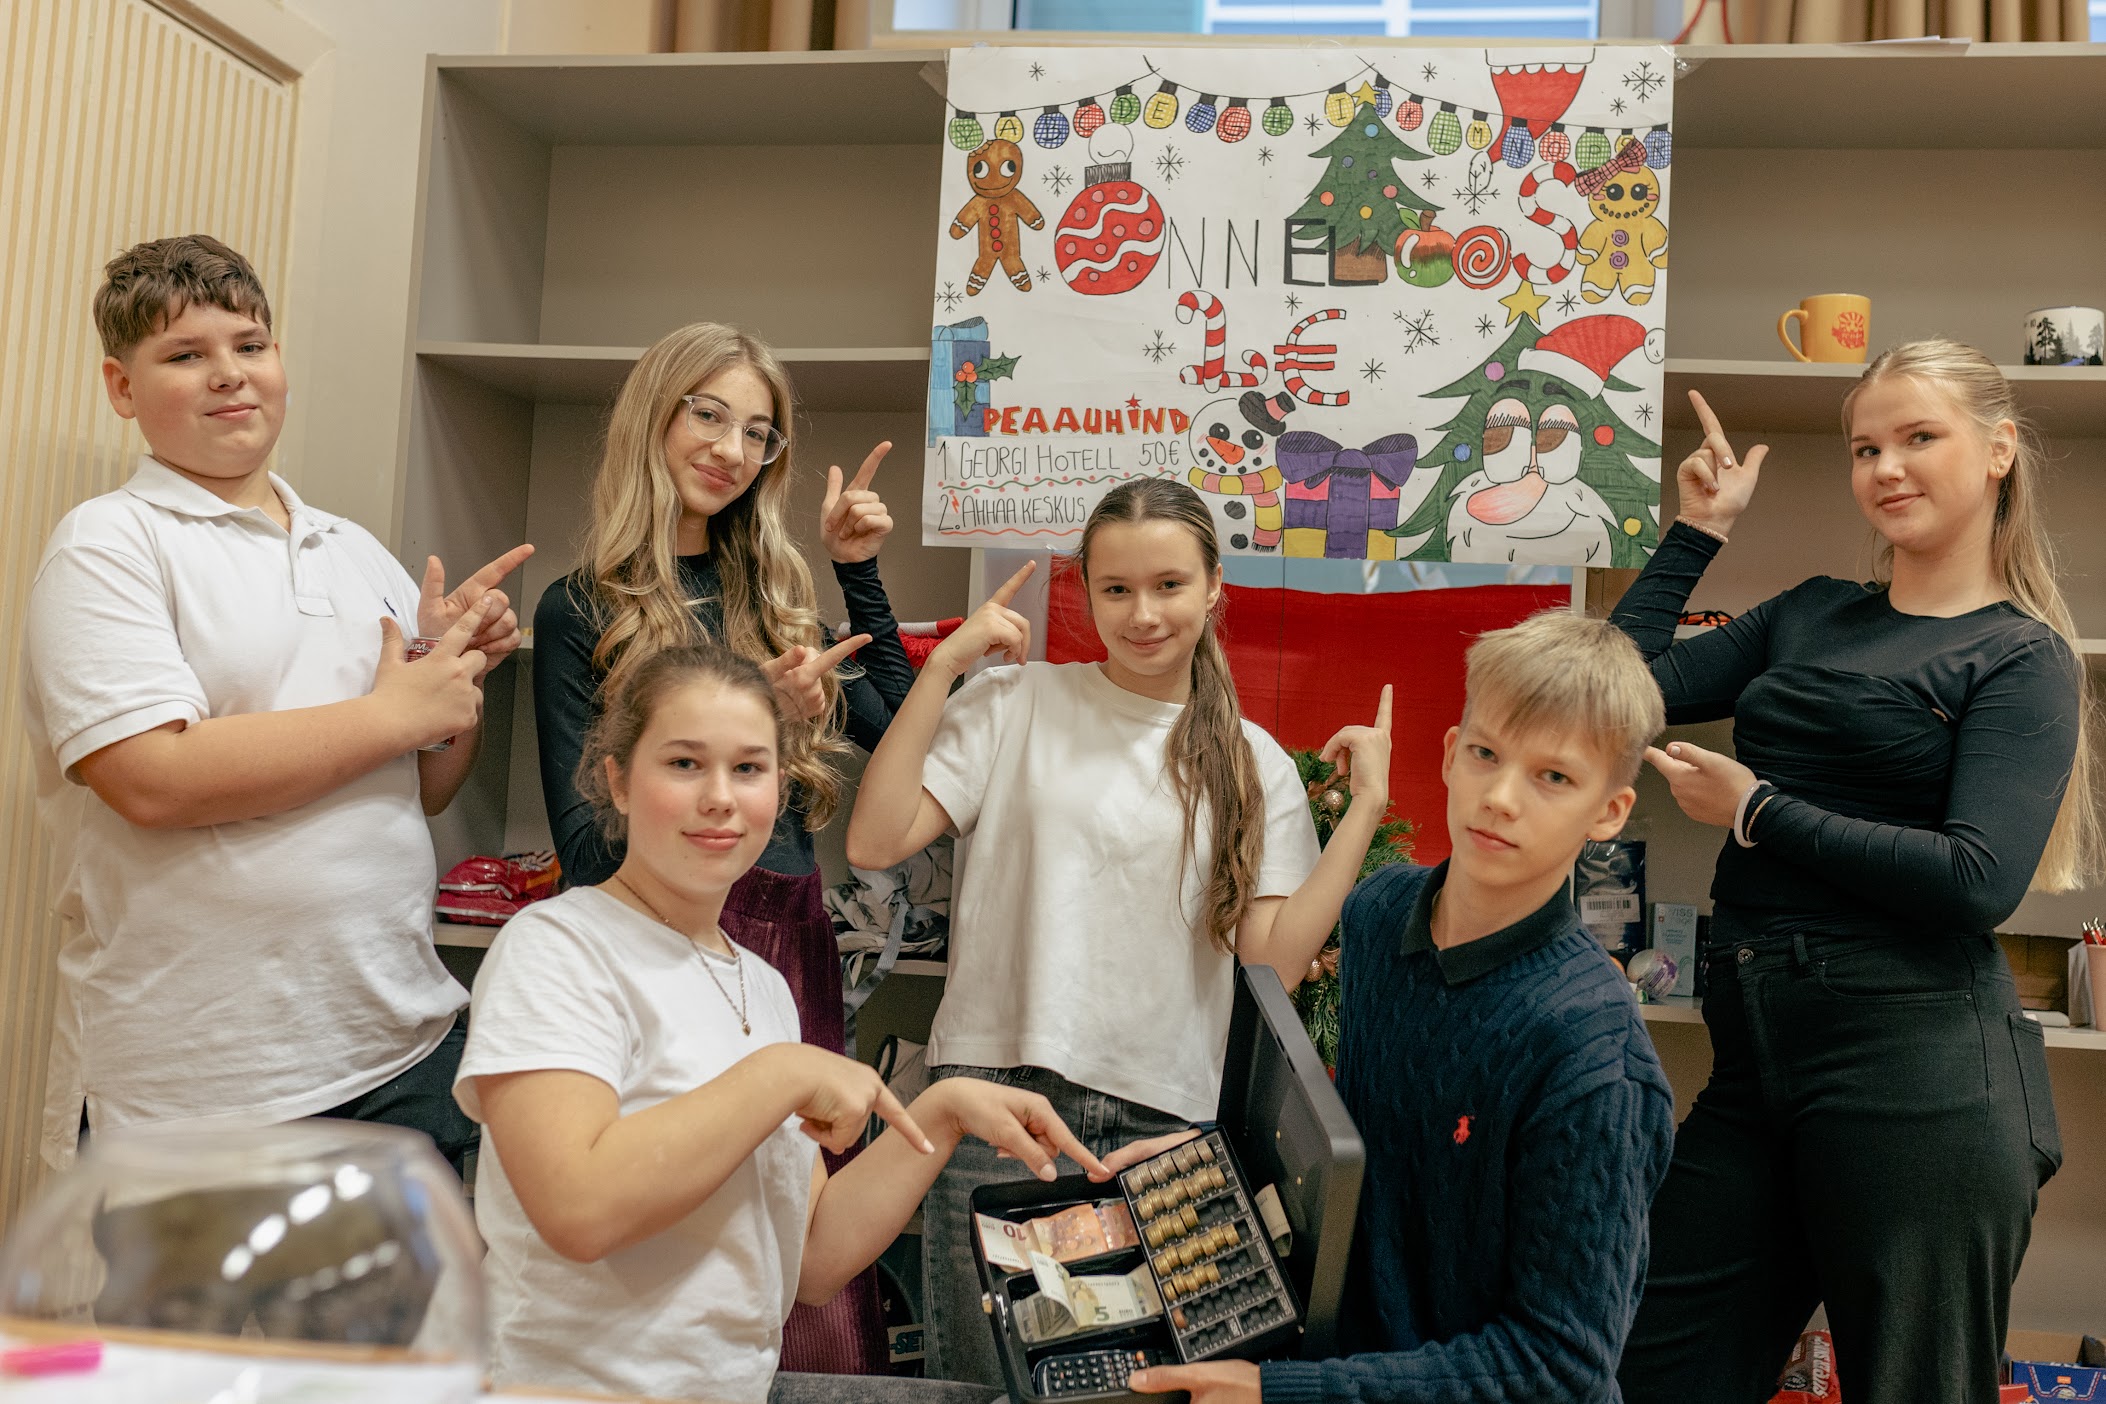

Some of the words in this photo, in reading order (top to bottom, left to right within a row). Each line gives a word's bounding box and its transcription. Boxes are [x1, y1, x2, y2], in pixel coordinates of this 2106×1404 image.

[1000, 119, 1017, 137] A
[1042, 115, 1062, 141] B
[1079, 109, 1097, 131] C
[1119, 97, 1133, 119] D
[1153, 101, 1169, 120] E
[1223, 111, 1243, 137] G
[1271, 111, 1284, 129] H
[1335, 97, 1347, 121] I
[1405, 109, 1416, 123] K
[1439, 129, 1451, 145] L
[1472, 126, 1483, 144] M
[1509, 137, 1524, 159] N
[1548, 140, 1562, 157] O
[1589, 144, 1601, 161] P
[1652, 138, 1666, 161] R
[960, 441, 1027, 480] GEORGI
[1138, 440, 1181, 467] 50€
[962, 495, 1017, 528] AHHAA
[1022, 494, 1087, 524] KESKUS
[1094, 1306, 1110, 1323] 5
